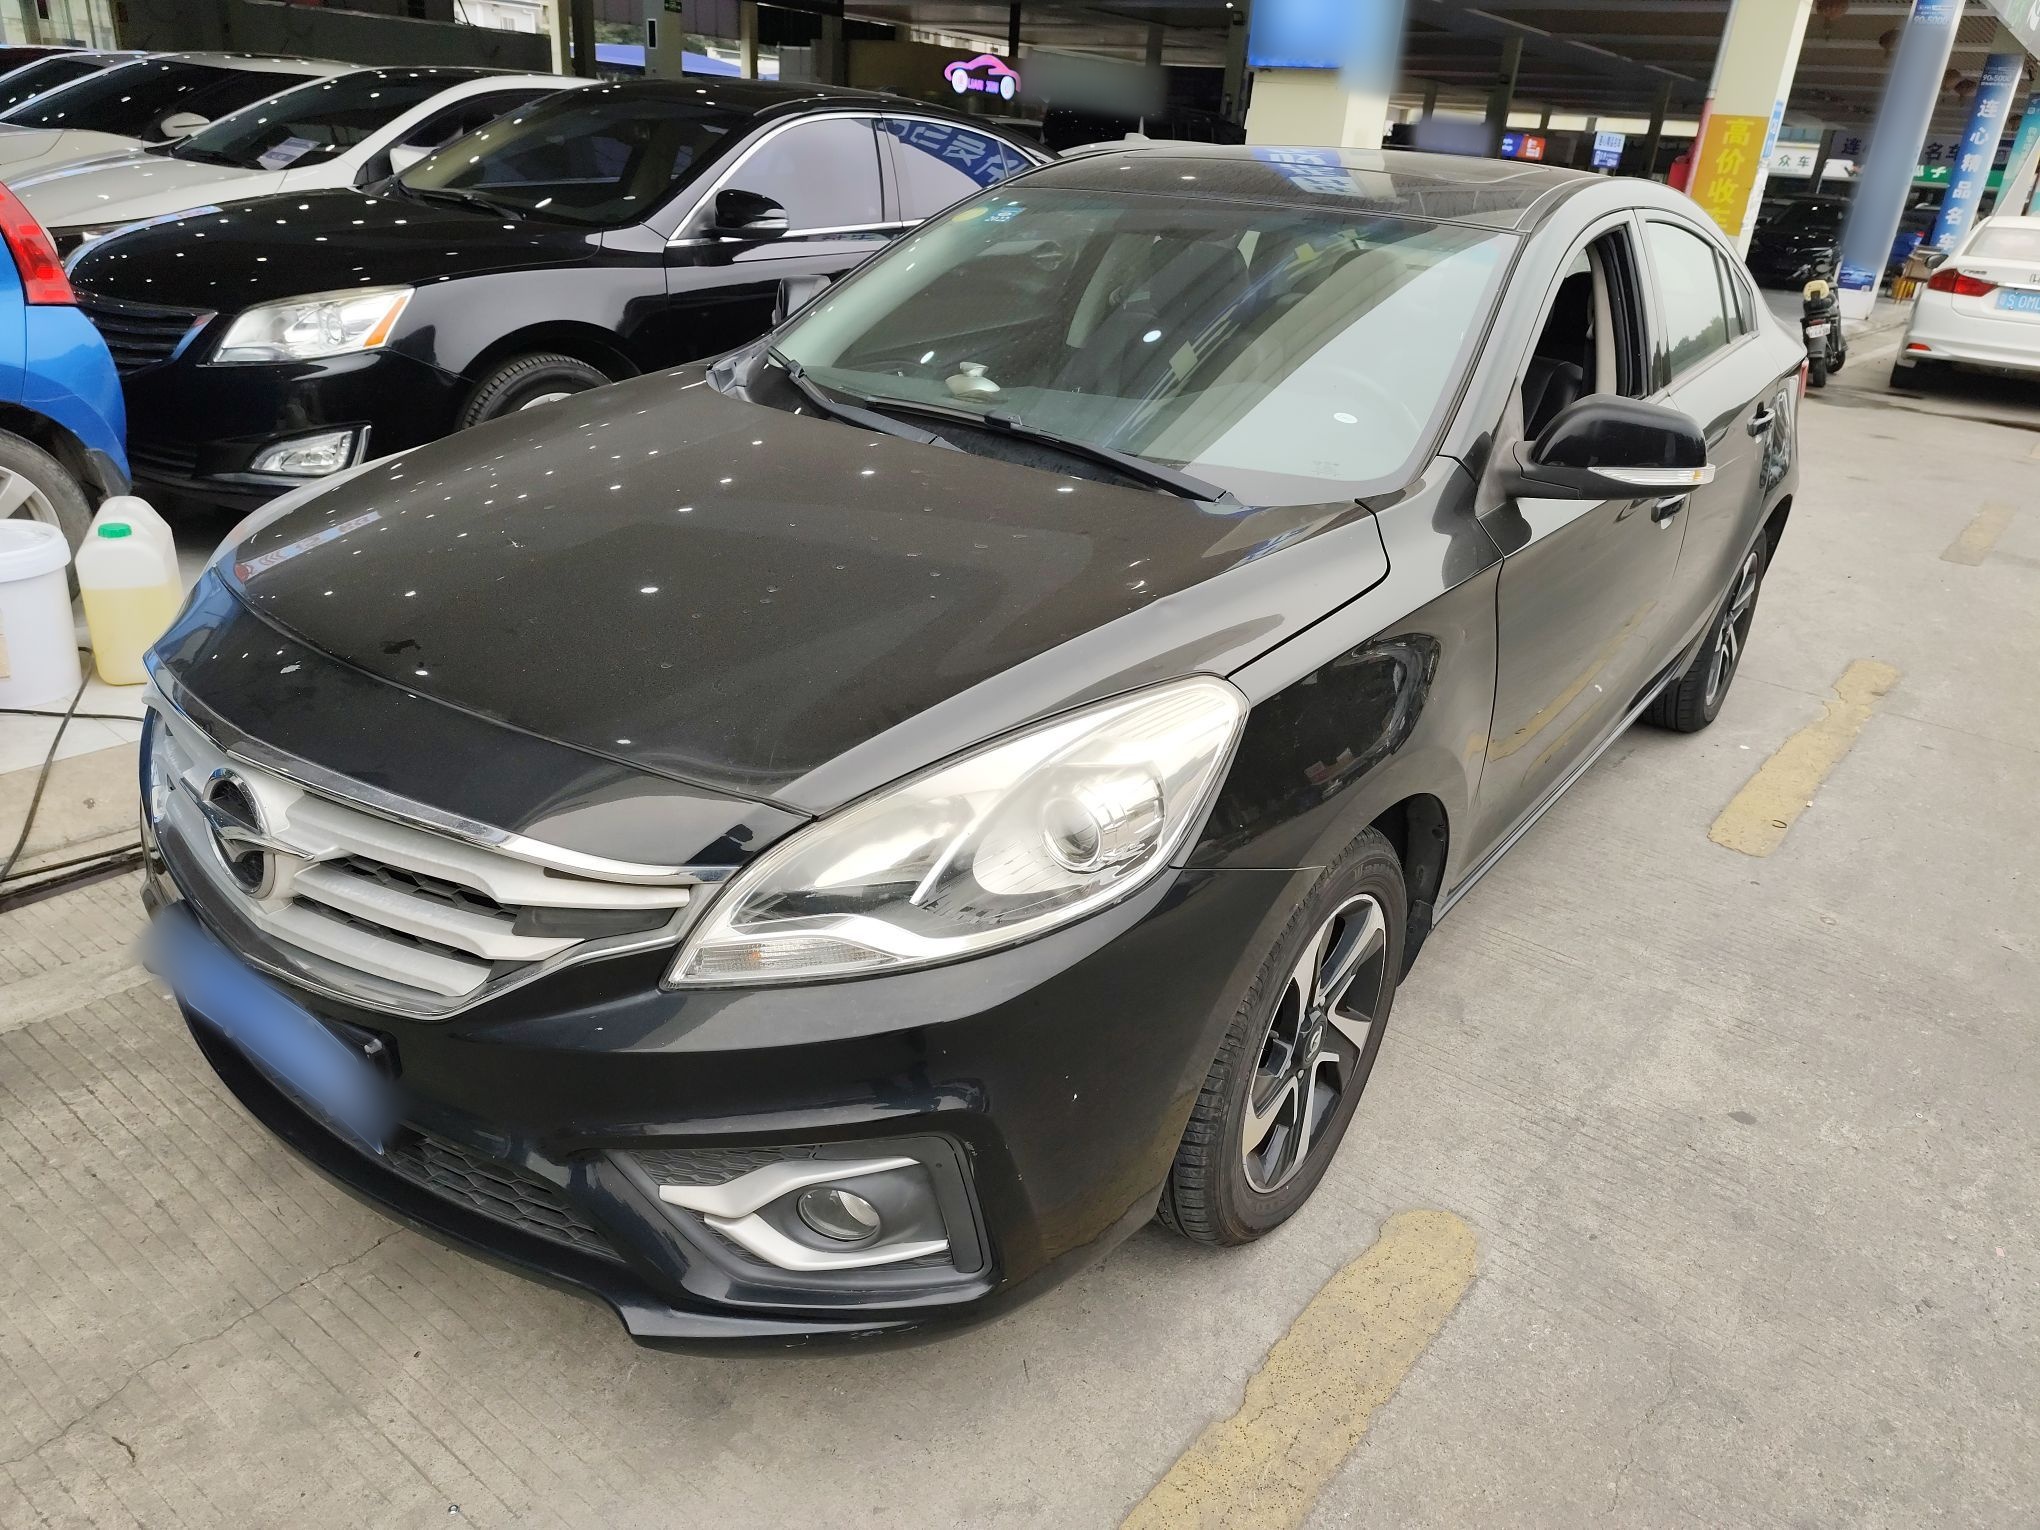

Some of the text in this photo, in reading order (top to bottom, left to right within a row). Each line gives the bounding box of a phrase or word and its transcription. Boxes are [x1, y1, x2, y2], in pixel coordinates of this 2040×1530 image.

[1937, 99, 2001, 250] 连心精品名车
